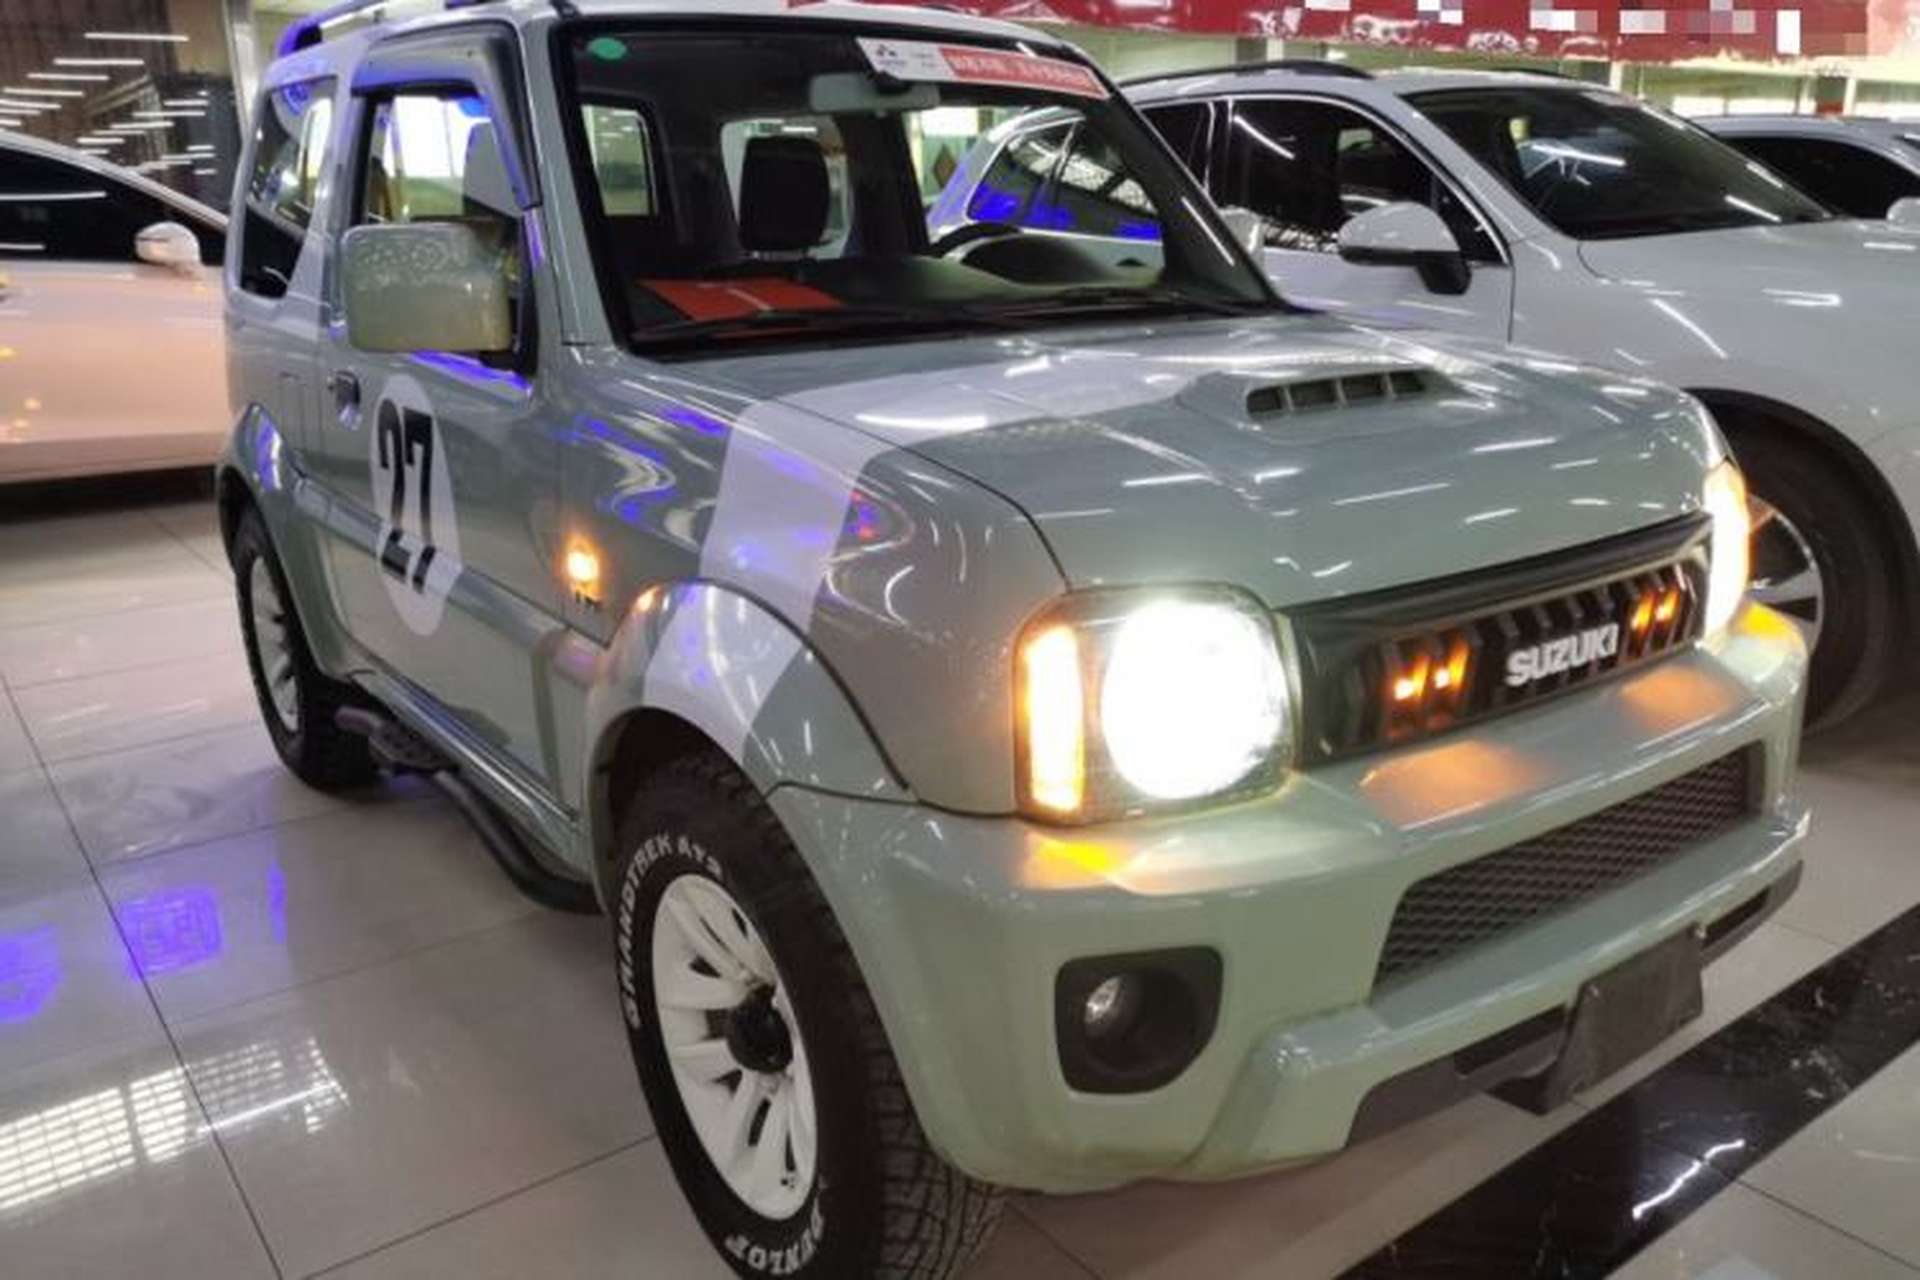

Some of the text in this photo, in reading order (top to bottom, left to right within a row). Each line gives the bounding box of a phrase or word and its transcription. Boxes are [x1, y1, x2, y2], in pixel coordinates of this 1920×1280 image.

[378, 399, 436, 593] 27
[1505, 622, 1620, 687] SUZUKI
[724, 1197, 825, 1276] DUNLOP
